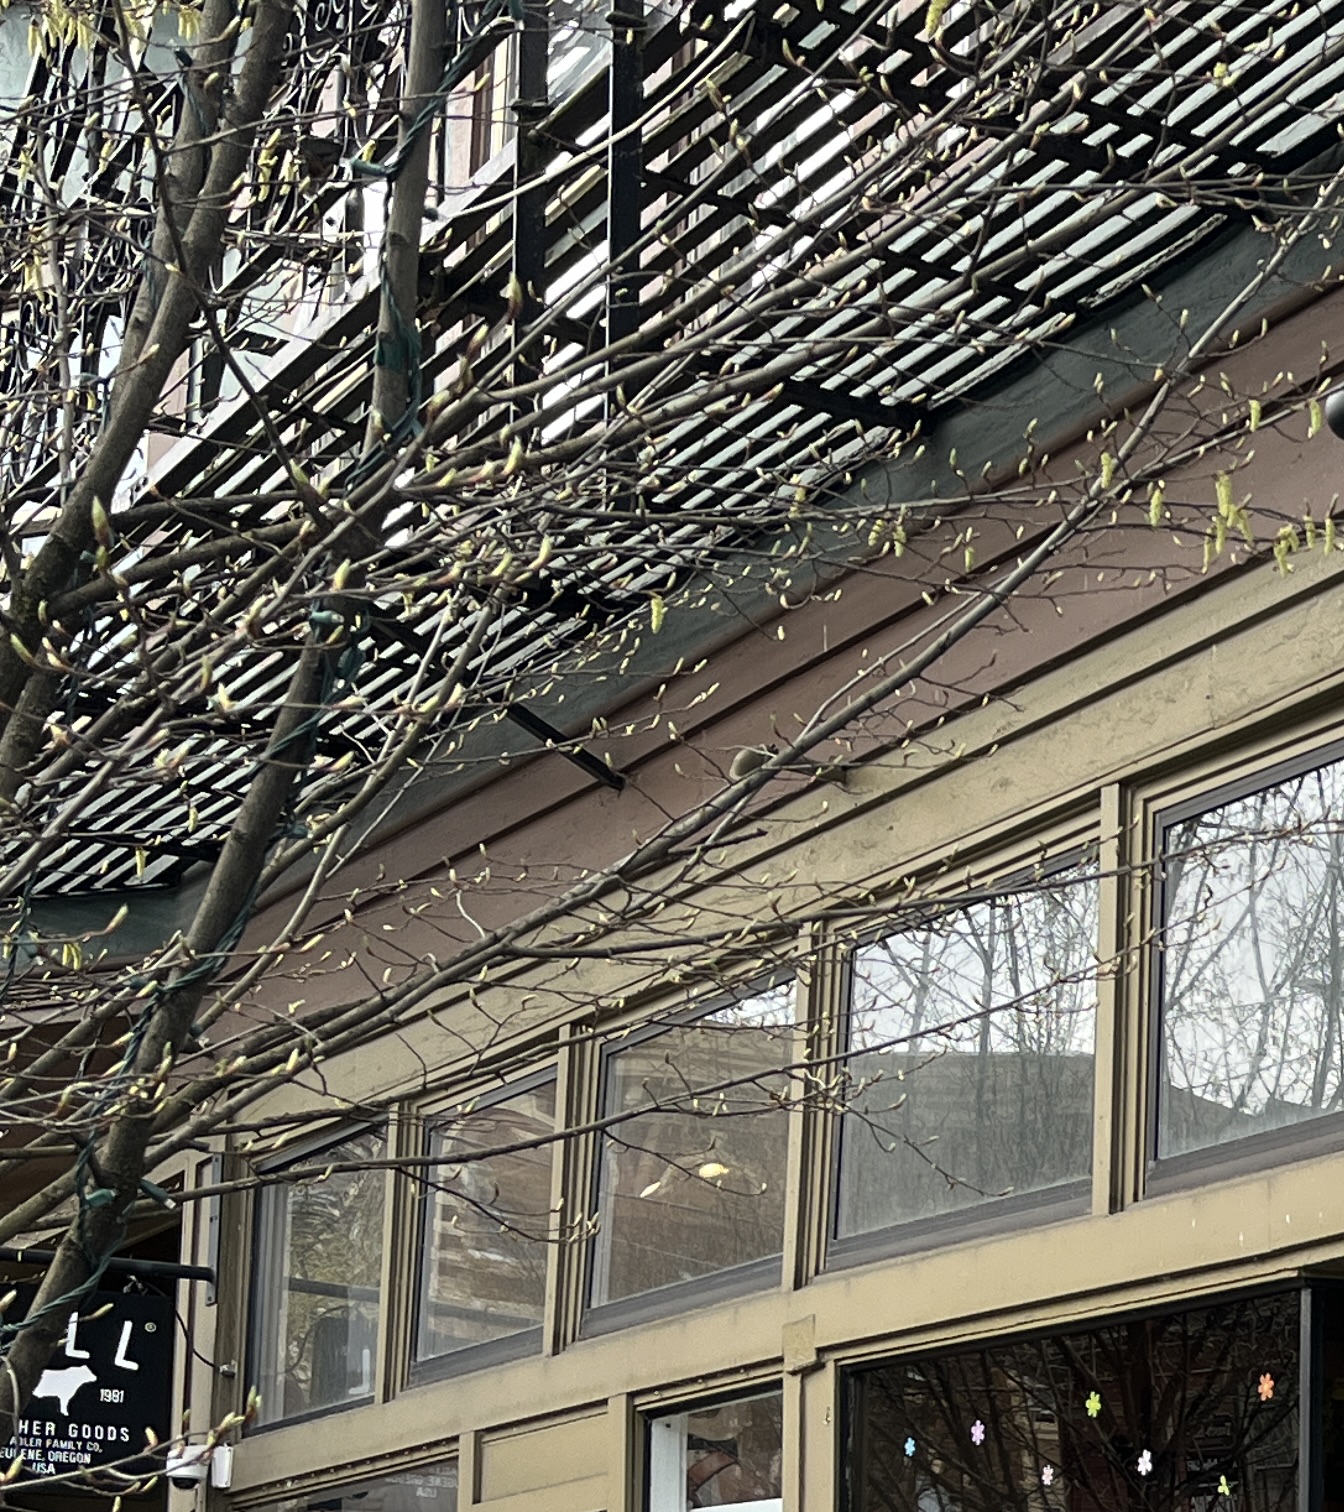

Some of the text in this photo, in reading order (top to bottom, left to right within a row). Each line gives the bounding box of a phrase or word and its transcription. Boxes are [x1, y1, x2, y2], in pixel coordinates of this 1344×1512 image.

[100, 1388, 124, 1404] 1981
[68, 1423, 130, 1442] GOODS
[45, 1438, 82, 1450] FAMILY
[47, 1450, 91, 1464] OREGON
[32, 1462, 56, 1475] USA
